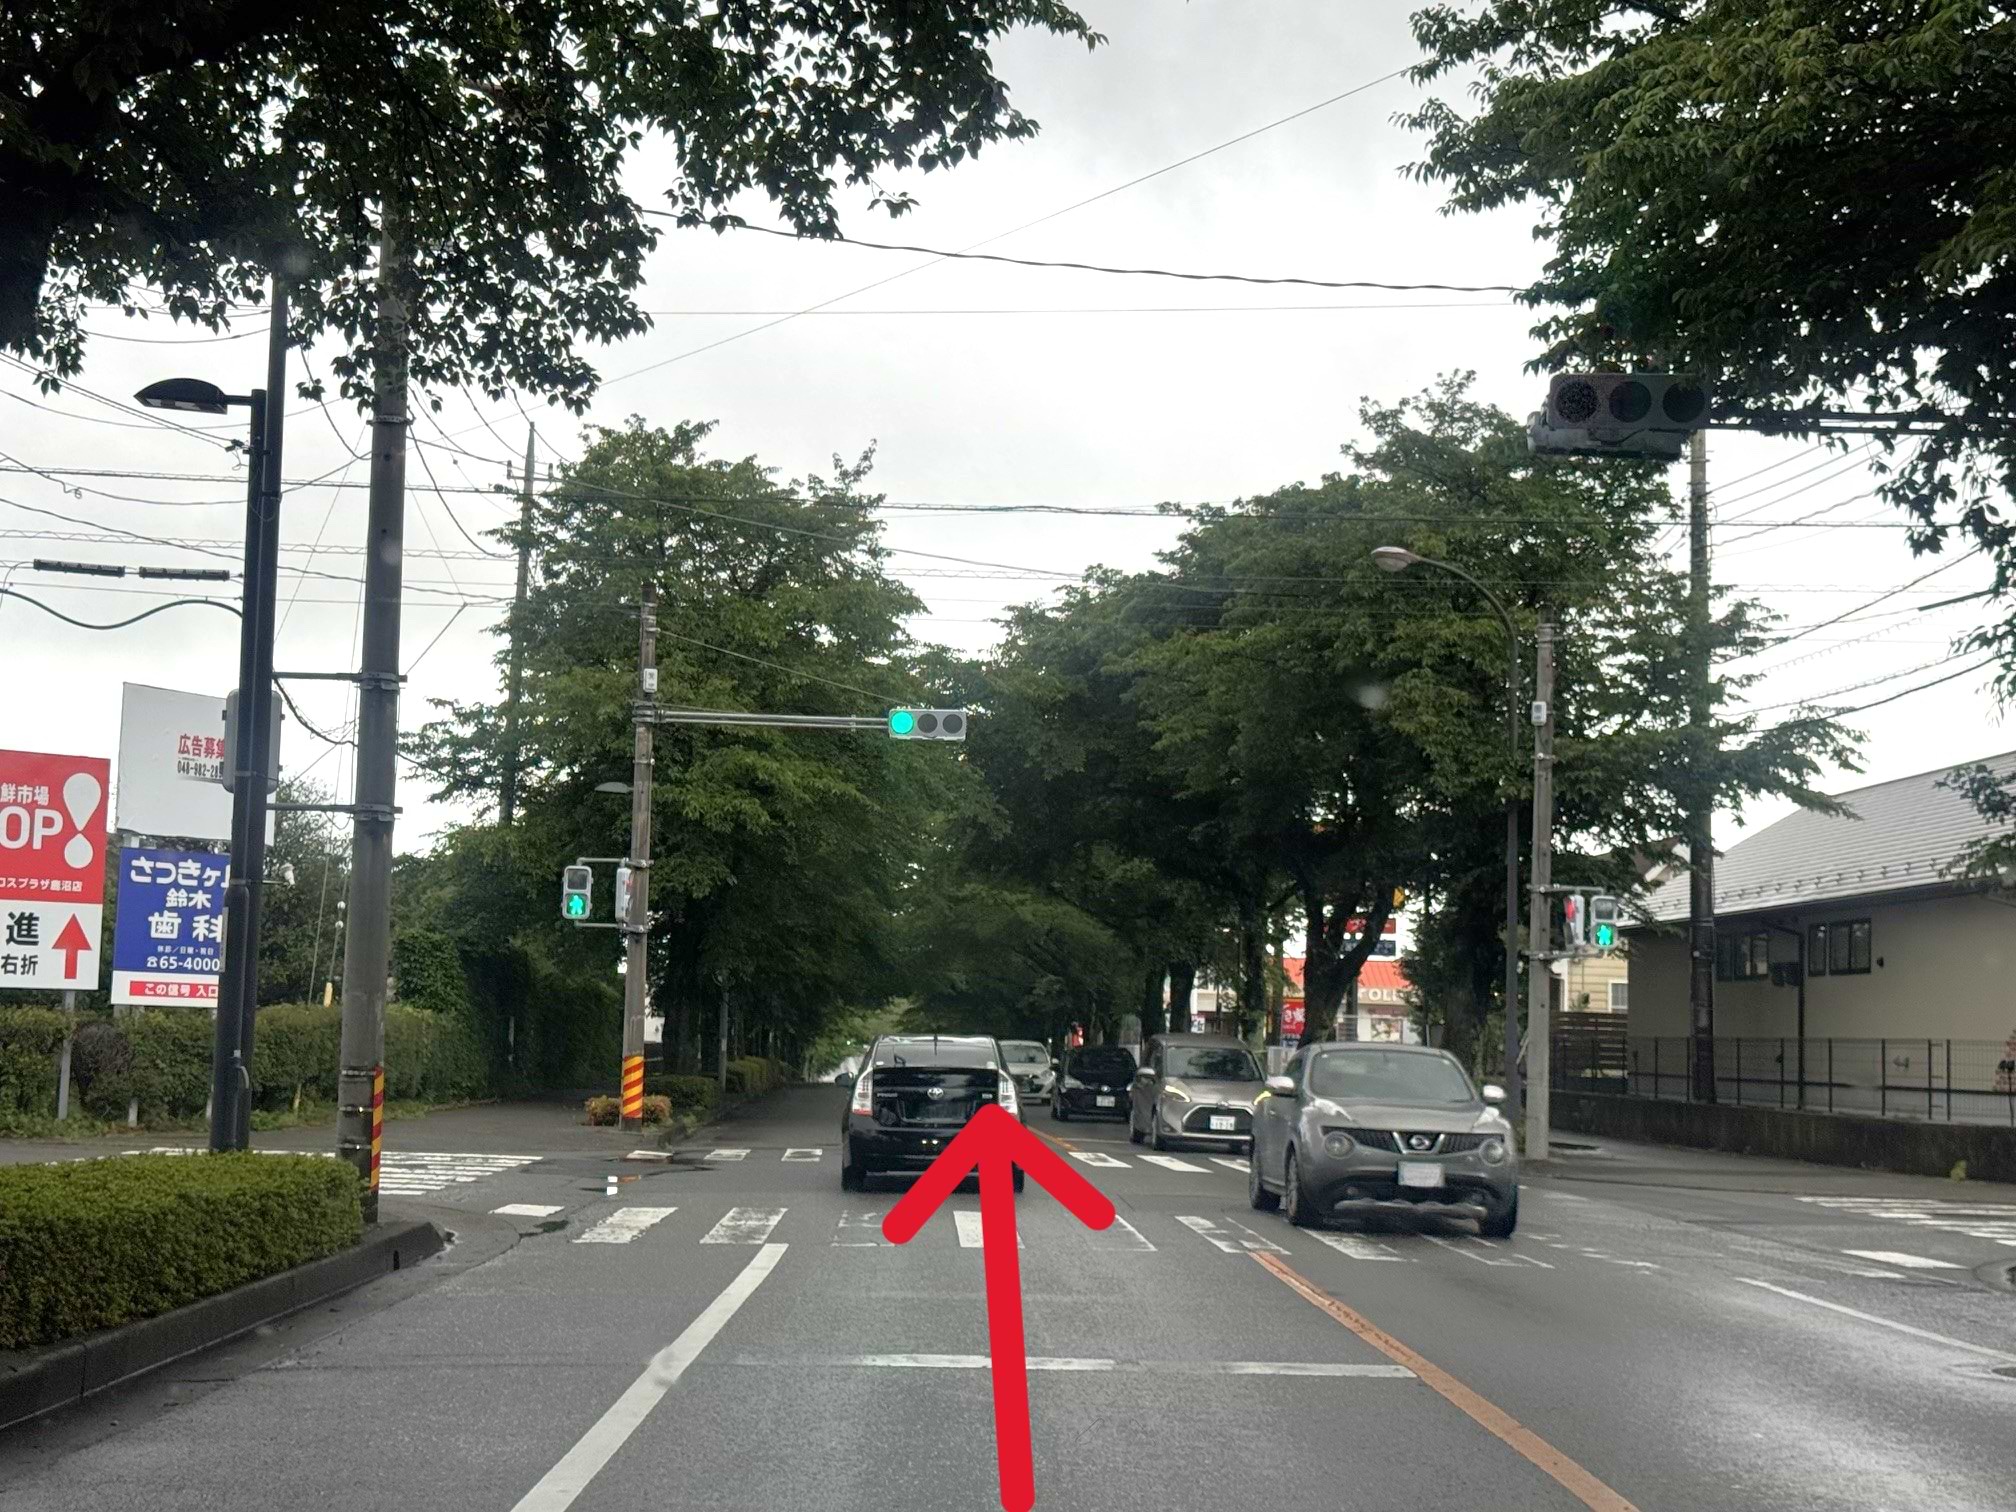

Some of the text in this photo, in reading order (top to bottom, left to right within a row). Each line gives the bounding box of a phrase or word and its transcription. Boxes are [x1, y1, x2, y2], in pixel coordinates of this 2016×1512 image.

[165, 888, 212, 909] 鈴木
[6, 911, 40, 946] 進
[1, 953, 38, 976] 右折
